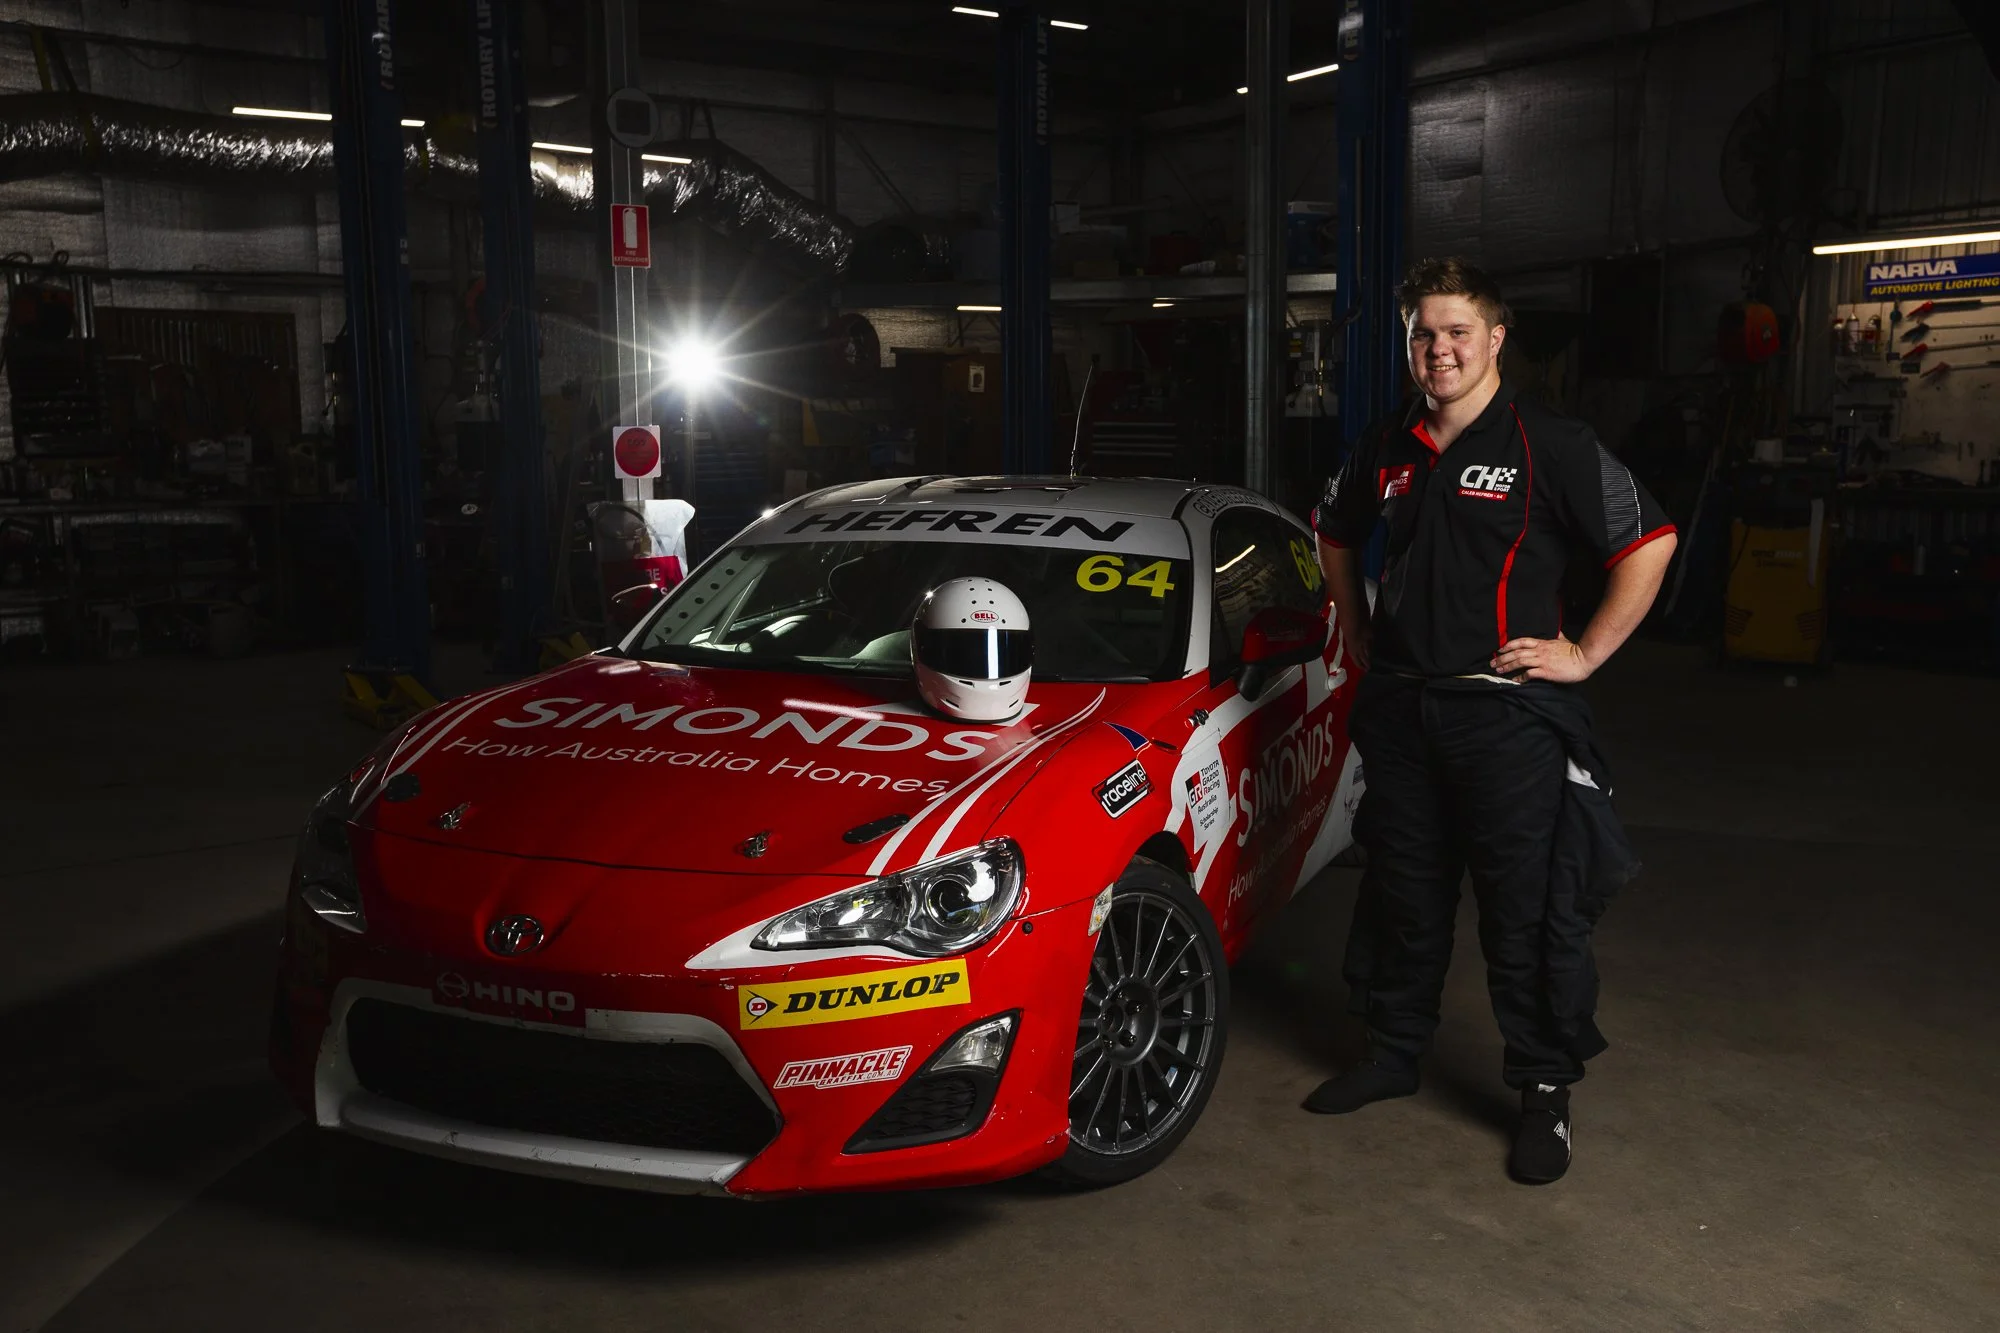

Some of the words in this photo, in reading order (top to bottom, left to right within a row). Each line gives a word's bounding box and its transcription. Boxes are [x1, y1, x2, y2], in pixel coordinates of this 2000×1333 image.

[479, 36, 497, 118] ROTARY
[1036, 60, 1048, 136] ROTARY
[1870, 259, 1958, 281] NARVA
[1870, 283, 1943, 296] AUTOMOTIVE
[1945, 277, 2000, 290] LIGHTING
[784, 509, 1135, 543] HEFREN
[1075, 554, 1176, 599] 64
[974, 612, 996, 620] BELL
[498, 697, 997, 761] SIMONDS
[441, 736, 546, 758] How
[546, 740, 757, 773] Australia
[767, 757, 949, 795] Homes
[1237, 711, 1334, 848] SIMONDS
[1102, 769, 1146, 807] raceline
[1203, 779, 1221, 796] Racing
[473, 981, 576, 1012] HINO
[783, 972, 961, 1014] DUNLOP
[780, 1051, 907, 1088] PINNACLE
